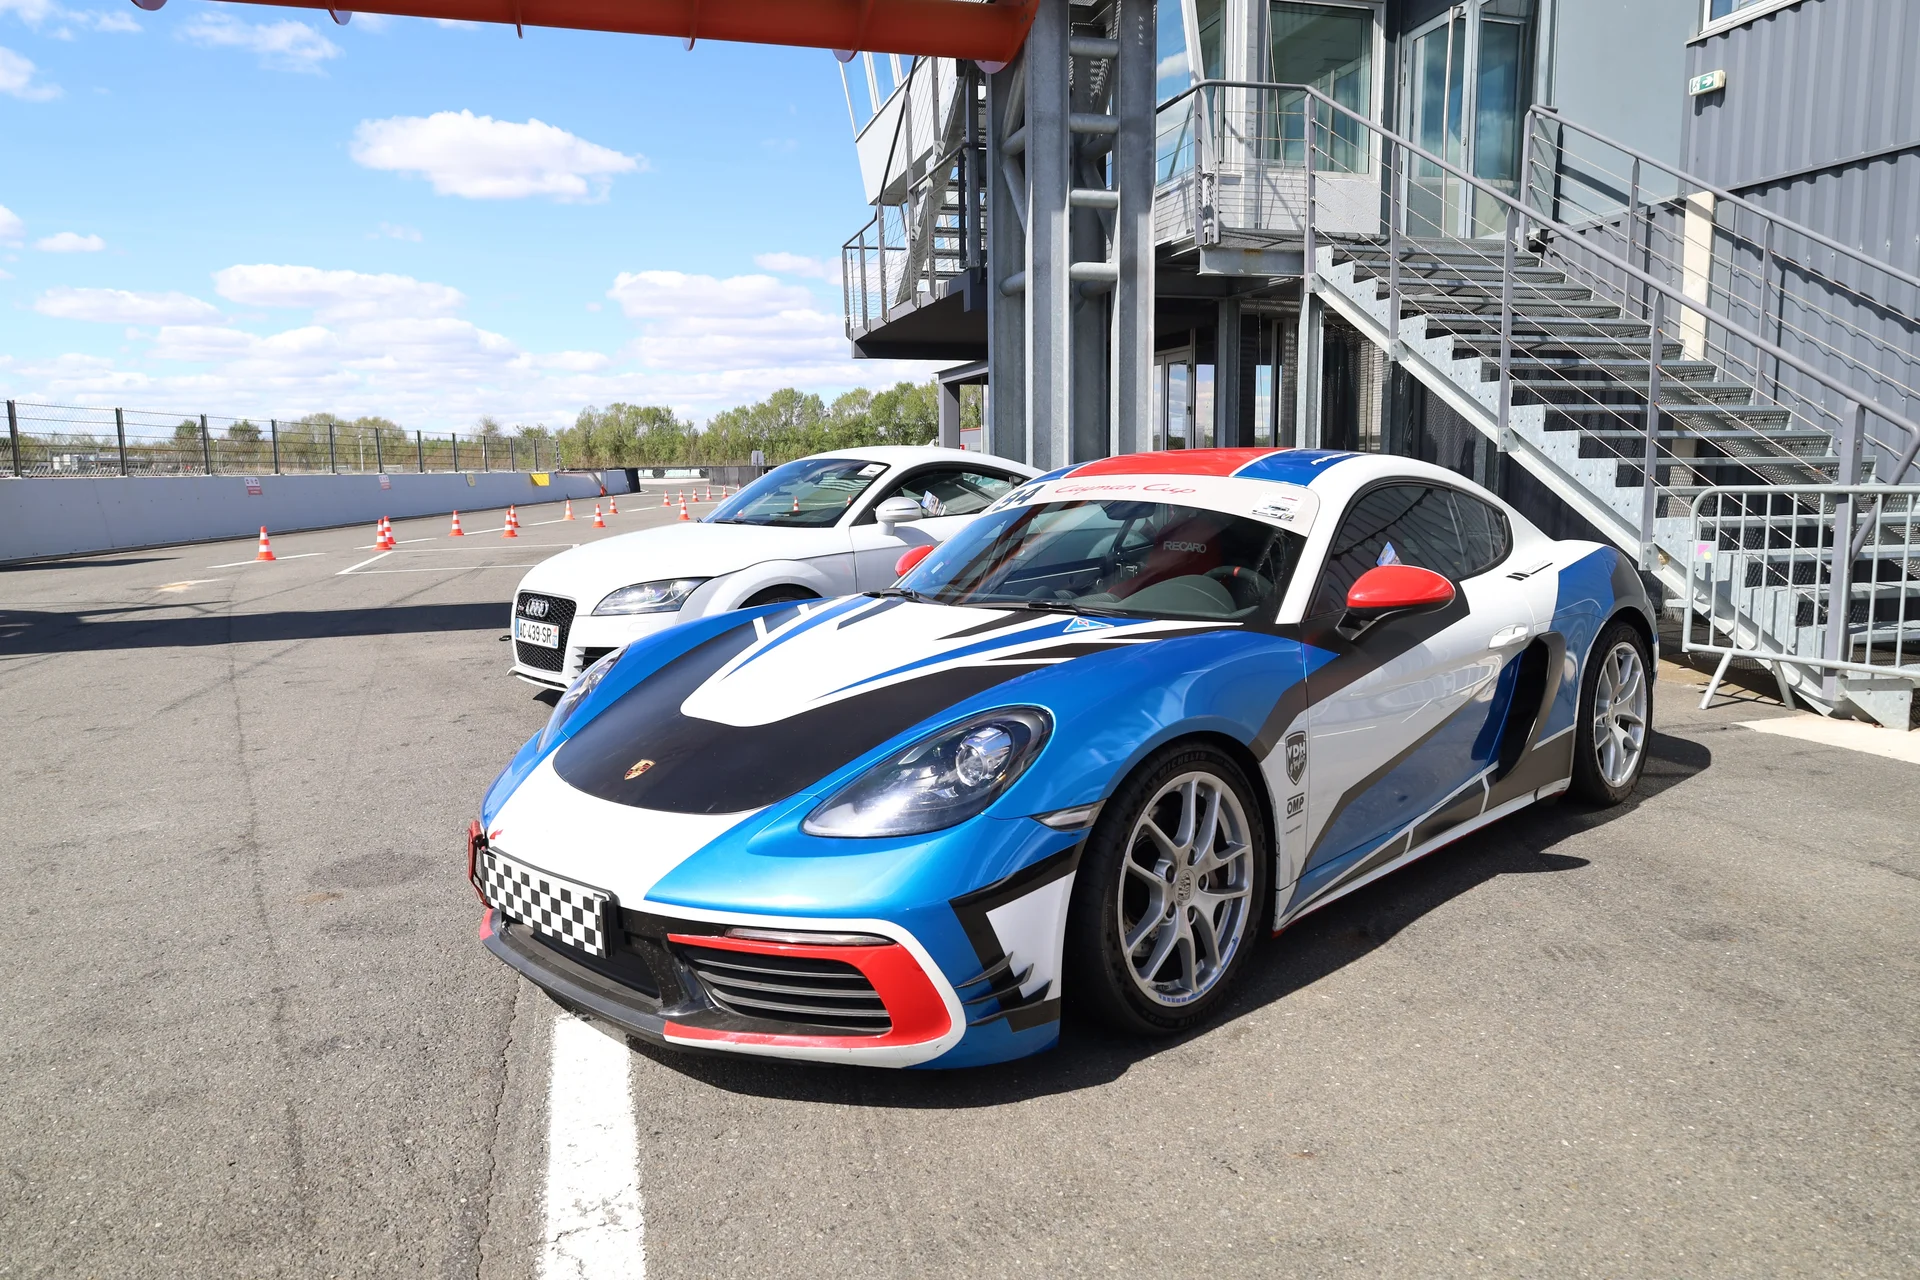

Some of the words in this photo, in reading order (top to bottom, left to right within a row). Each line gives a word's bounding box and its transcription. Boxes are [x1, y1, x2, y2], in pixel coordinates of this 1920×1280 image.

[992, 484, 1046, 512] 94
[1055, 484, 1136, 496] Cayman
[1142, 483, 1197, 495] Cup
[1163, 540, 1207, 554] RECARO
[519, 622, 552, 643] AC-439-SR
[1287, 741, 1306, 759] VDH
[1159, 751, 1207, 779] MICHELIN
[1286, 796, 1304, 815] OMP
